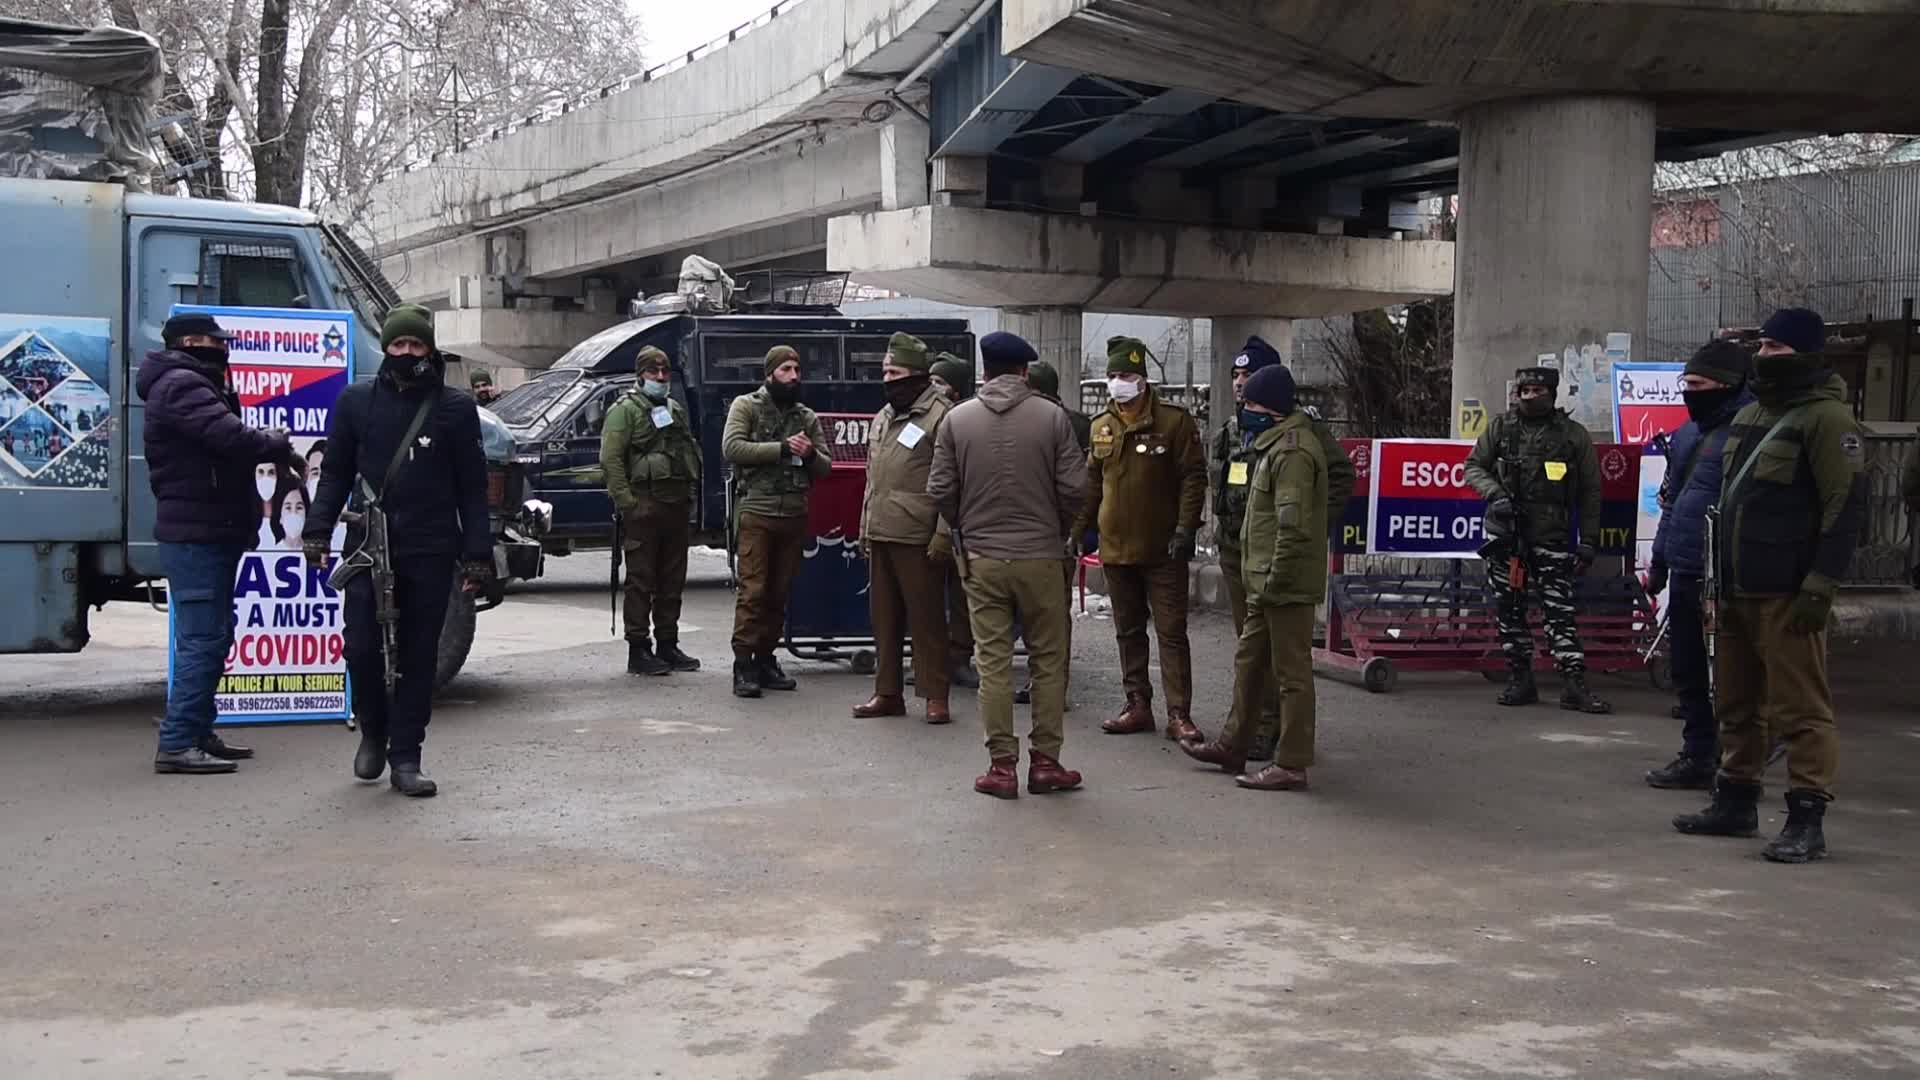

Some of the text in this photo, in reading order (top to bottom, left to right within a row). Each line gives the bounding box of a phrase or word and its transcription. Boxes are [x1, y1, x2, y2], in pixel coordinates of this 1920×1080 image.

[274, 331, 319, 353] POLICE
[232, 371, 293, 396] HAPPY
[293, 408, 328, 432] DAY
[1462, 409, 1483, 431] P7
[834, 420, 869, 445] 207
[1388, 515, 1445, 539] PEEL
[247, 604, 265, 628] A
[272, 603, 340, 628] MUST
[228, 676, 262, 692] POLICE
[263, 676, 275, 691] AT
[277, 675, 303, 691] YOUR
[305, 674, 345, 690] SERVICE
